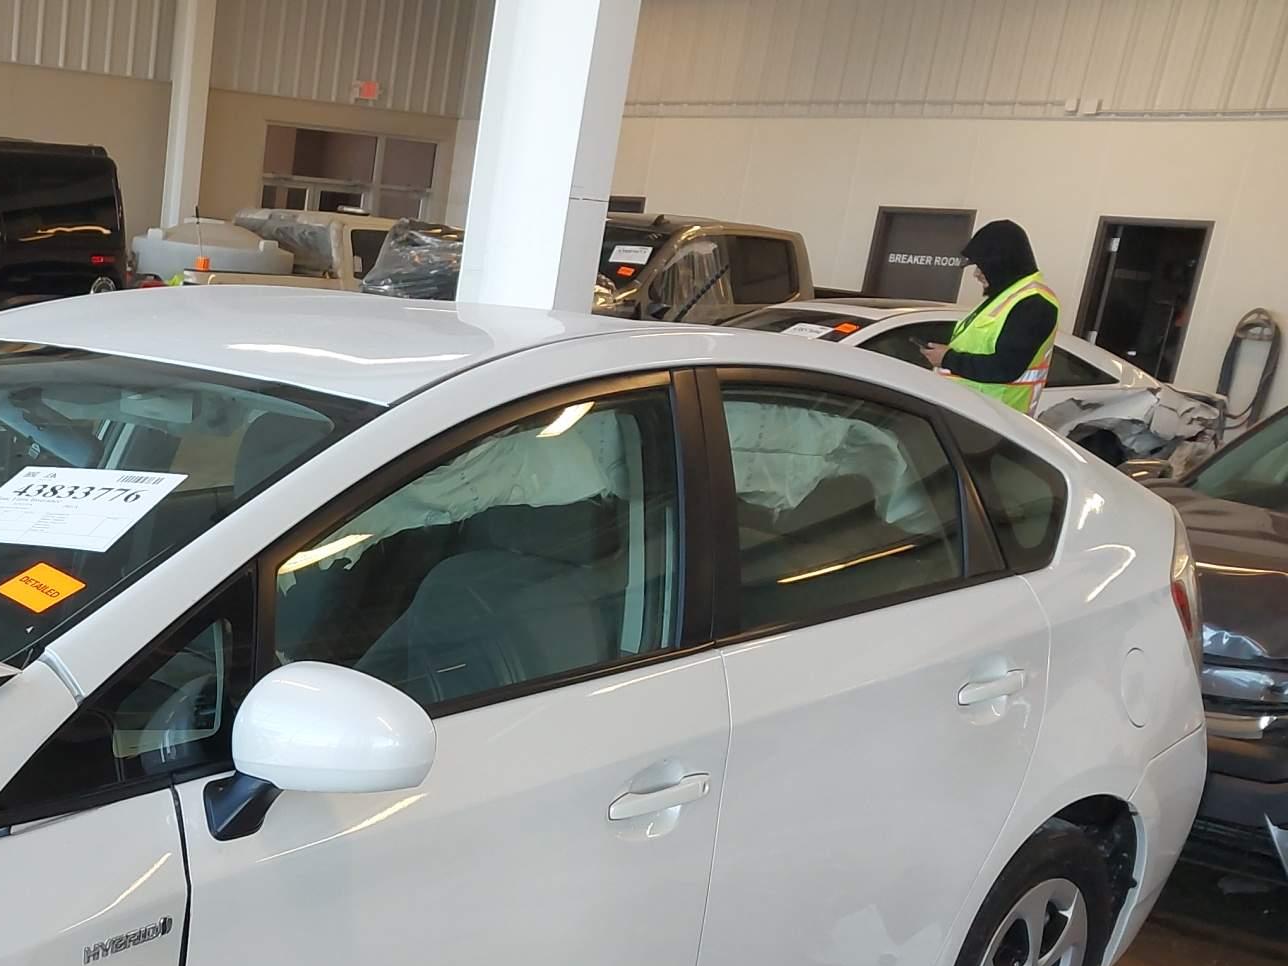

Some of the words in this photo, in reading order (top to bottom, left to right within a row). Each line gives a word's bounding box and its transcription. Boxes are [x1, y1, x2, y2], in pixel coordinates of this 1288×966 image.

[888, 253, 933, 265] BREAKER
[12, 483, 146, 503] 43833776
[19, 575, 60, 598] DETAILED
[83, 922, 160, 965] HYBRID
